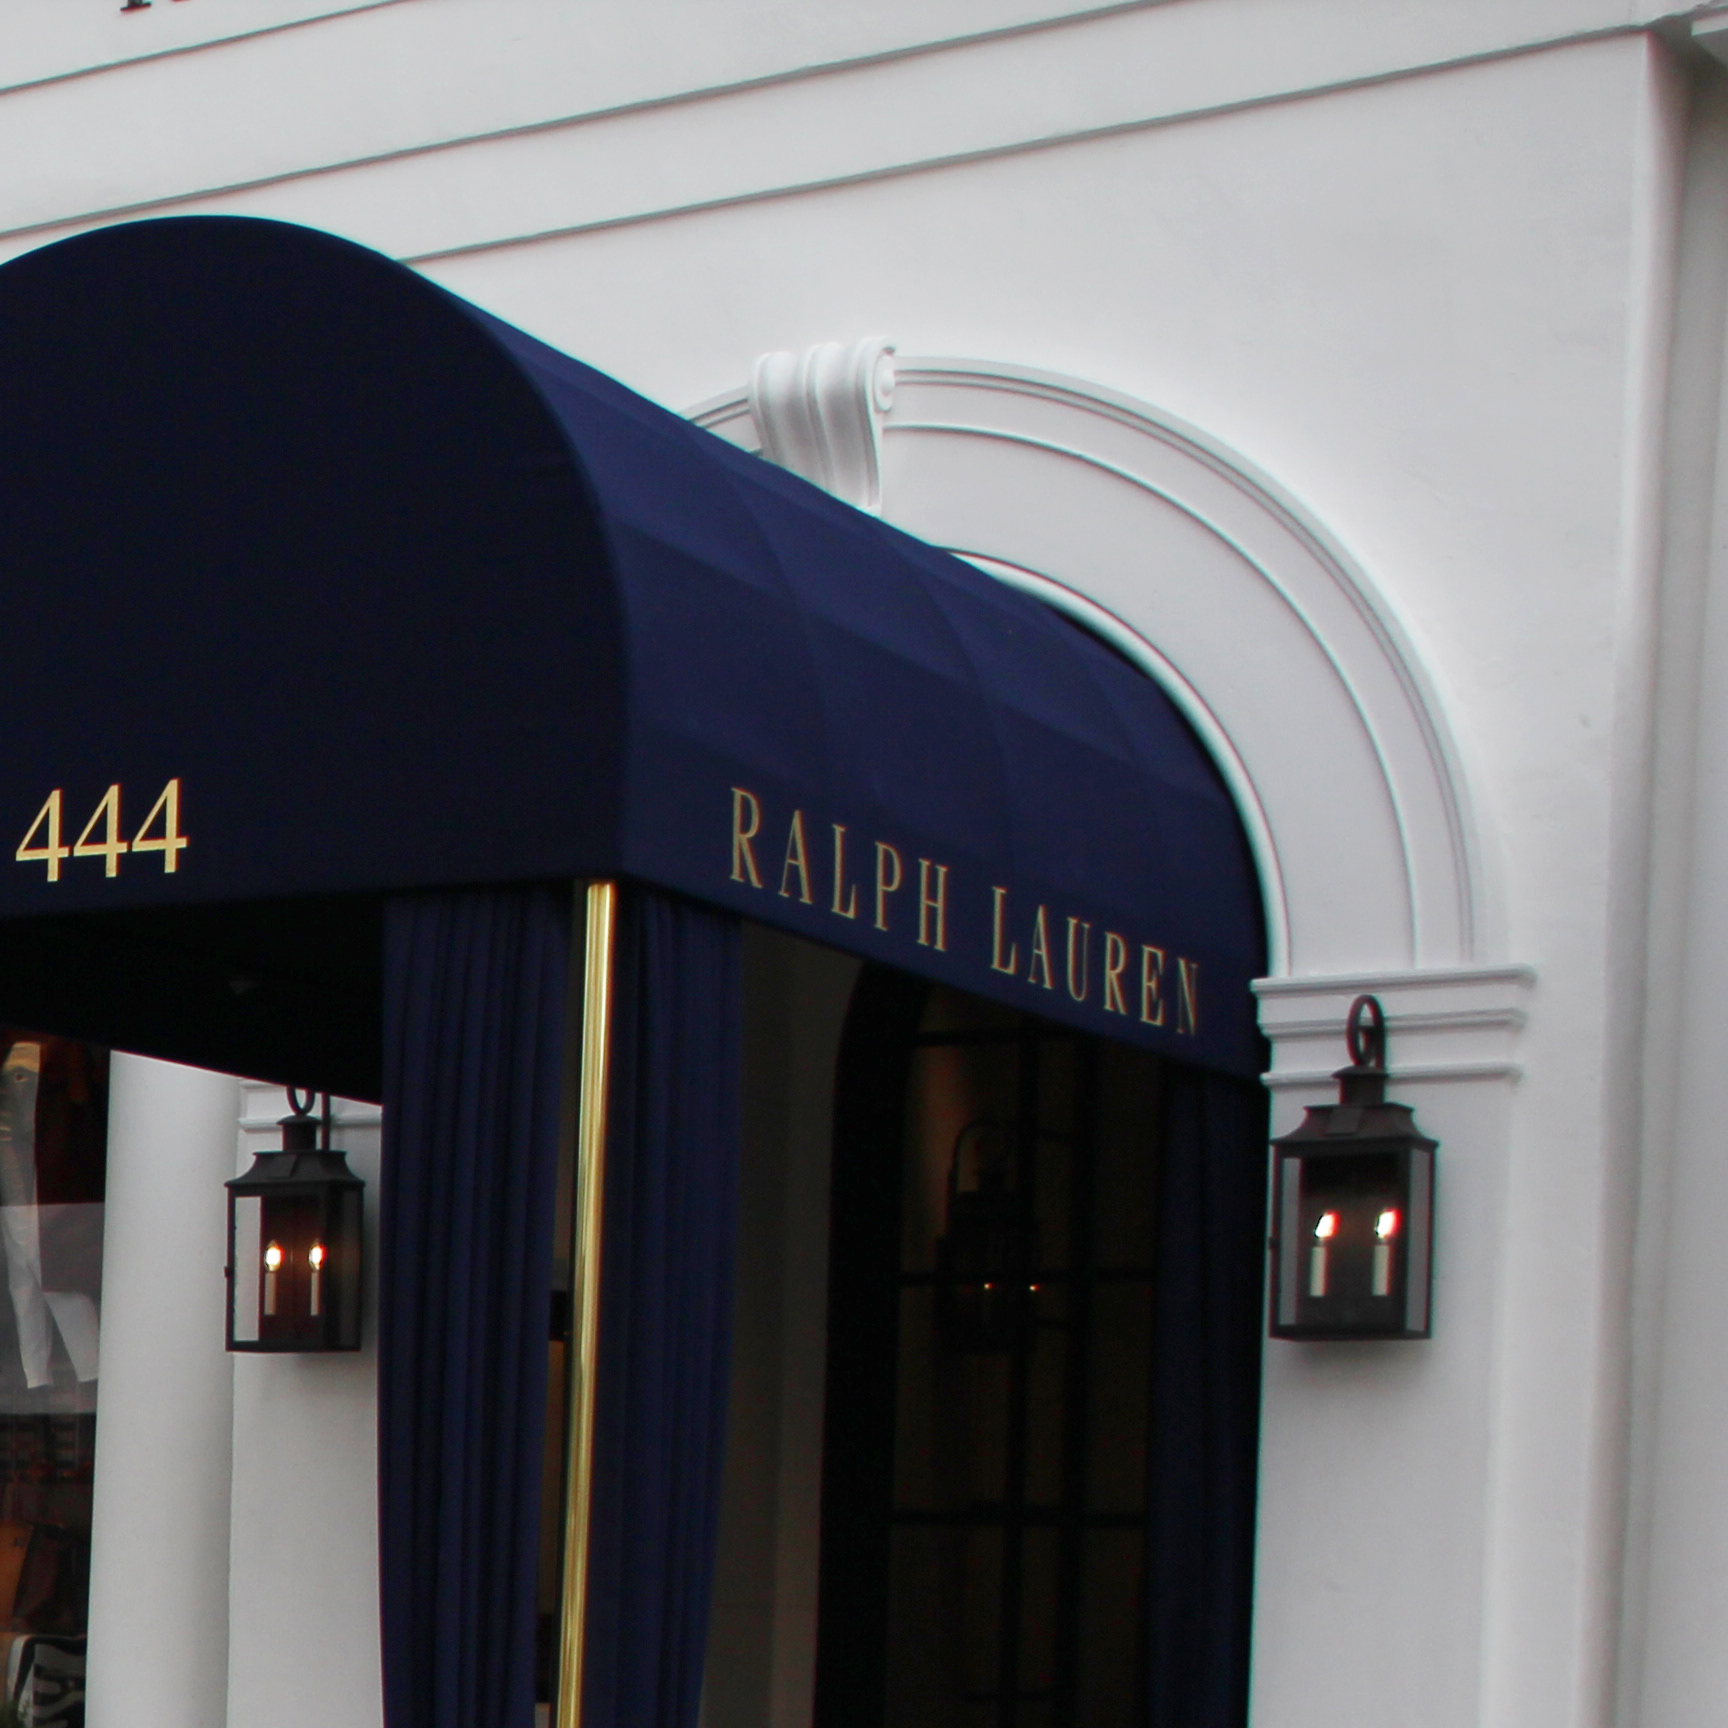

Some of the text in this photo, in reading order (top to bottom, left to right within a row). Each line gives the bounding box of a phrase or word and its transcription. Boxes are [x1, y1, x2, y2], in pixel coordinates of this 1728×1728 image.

[16, 777, 189, 882] 444
[730, 786, 1199, 1037] RALPH LAUREN
